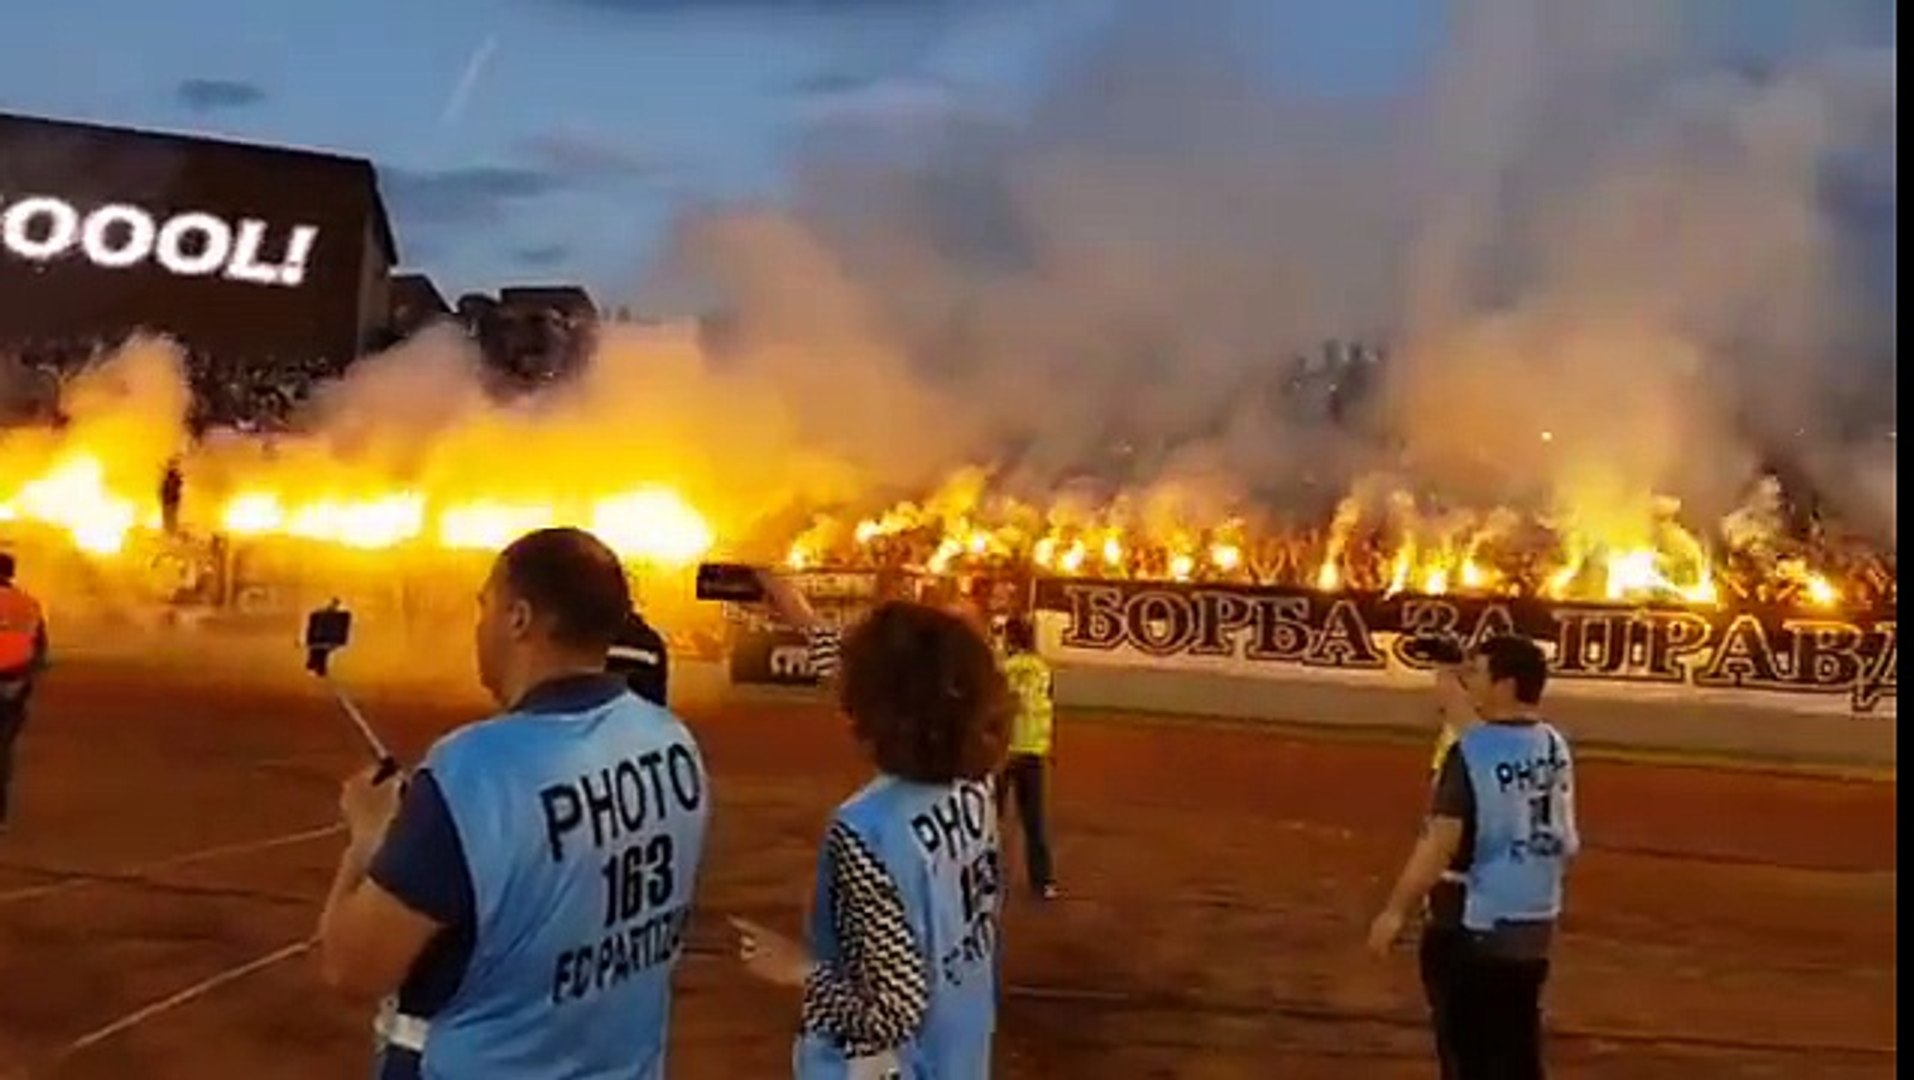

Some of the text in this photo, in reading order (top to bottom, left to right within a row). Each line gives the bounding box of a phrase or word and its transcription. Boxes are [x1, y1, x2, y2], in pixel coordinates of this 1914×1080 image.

[0, 196, 319, 286] OOOL!
[1062, 584, 1388, 670] БОРБА
[540, 743, 701, 862] PHOTO
[602, 834, 674, 928] 163
[552, 943, 593, 1004] FC
